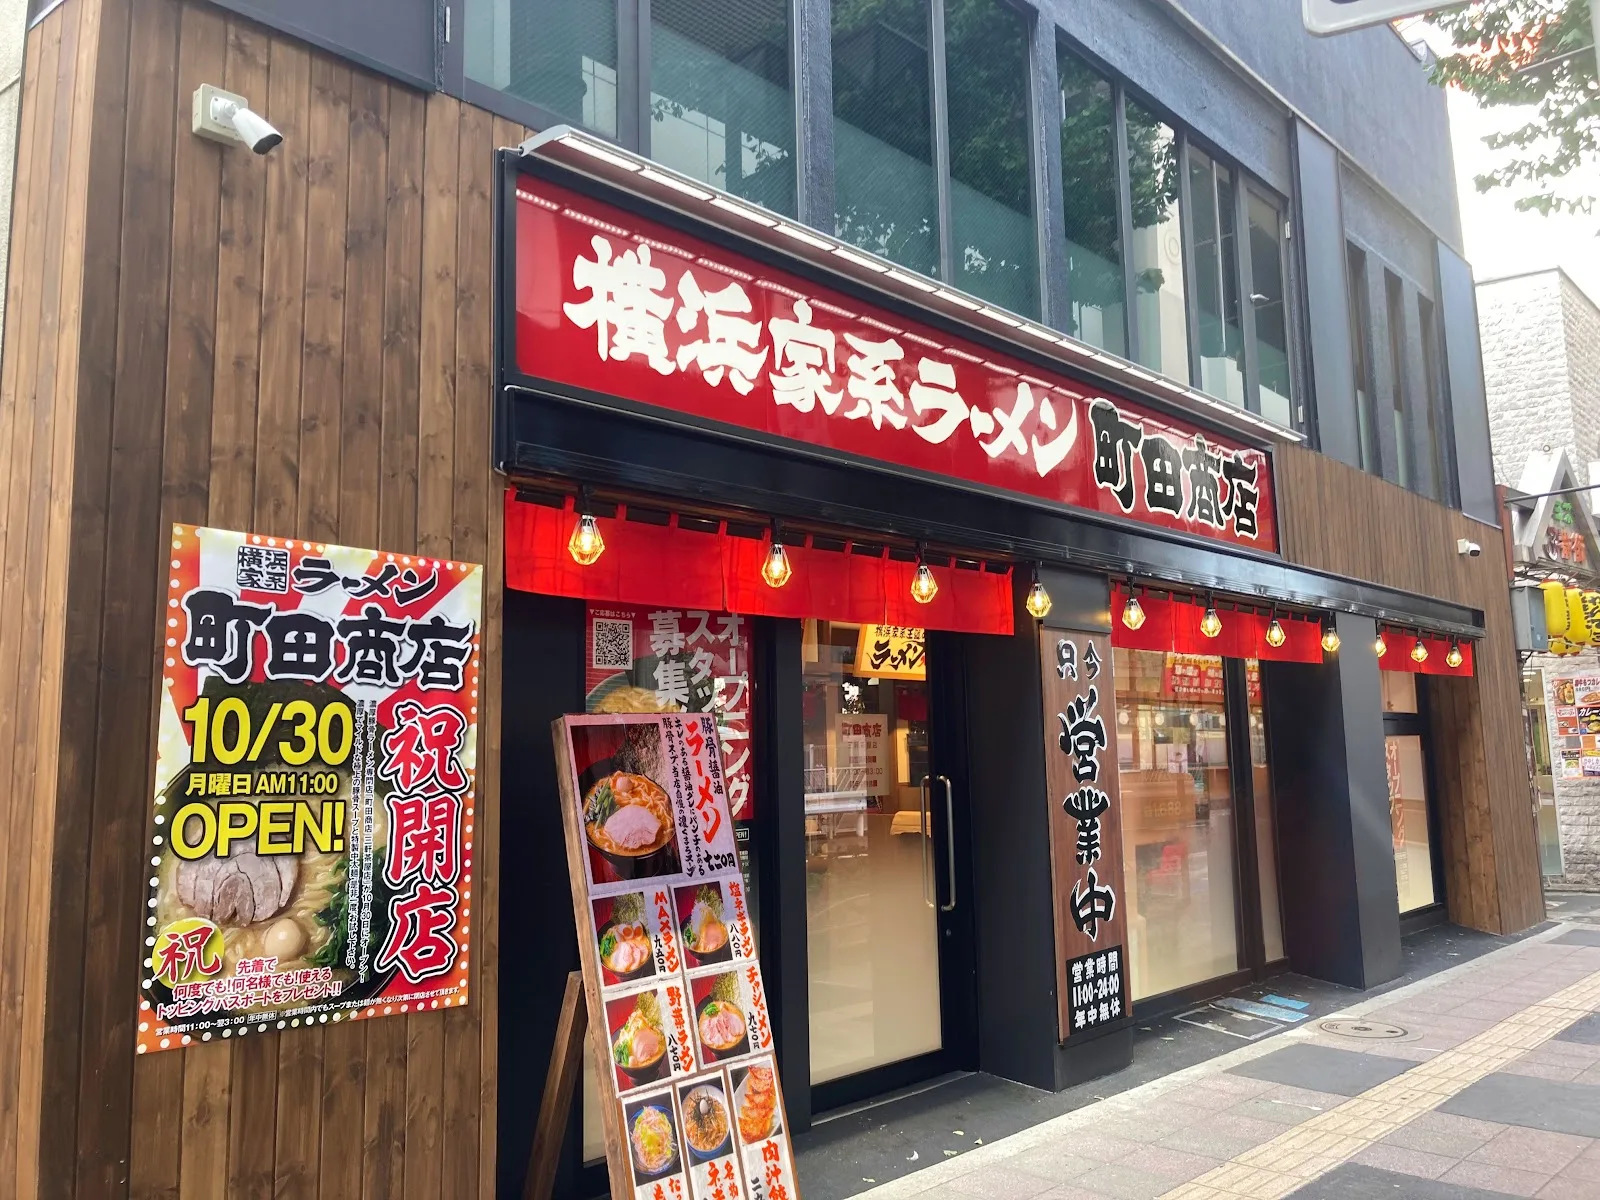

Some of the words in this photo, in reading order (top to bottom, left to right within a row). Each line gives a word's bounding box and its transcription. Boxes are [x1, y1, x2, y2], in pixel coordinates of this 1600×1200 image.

[562, 234, 1077, 478] 横浜家系ラーメン
[1088, 397, 1259, 540] 町田商店
[292, 557, 437, 604] ラーメン
[182, 589, 474, 689] 町田商店
[648, 610, 690, 712] 募集
[1056, 639, 1102, 681] 只今
[183, 697, 353, 766] 10/30
[717, 611, 750, 817] オープニング
[1578, 707, 1600, 717] カレー
[186, 772, 251, 797] 月曜日
[256, 773, 338, 795] AM11:00
[685, 720, 721, 844] ラーメン
[700, 717, 723, 795] 豚骨醤油
[170, 800, 346, 860] OPEN!
[378, 704, 465, 982] 祝開店
[1057, 684, 1116, 942] 営業中
[152, 926, 222, 984] 祝
[237, 957, 278, 976] 先着で
[654, 891, 680, 973] MAXラーメン
[1071, 950, 1119, 984] 営業時間
[666, 986, 694, 1072] 野菜ラーメン
[1074, 996, 1121, 1029] 年中無休
